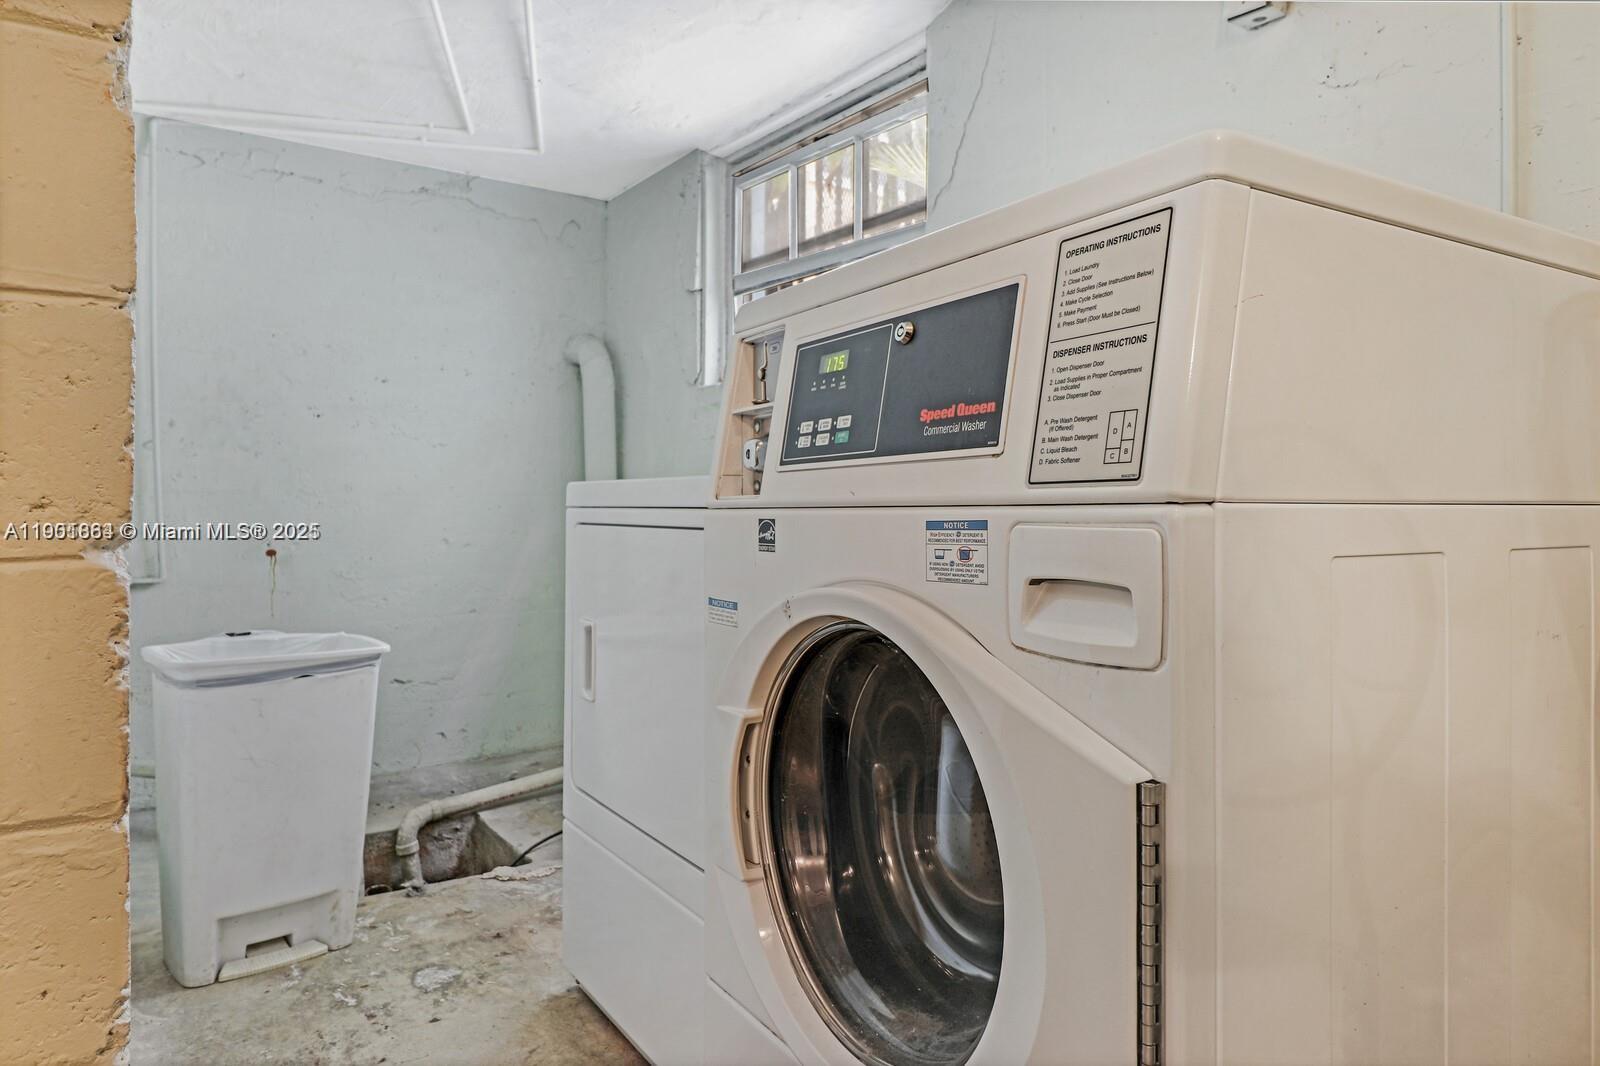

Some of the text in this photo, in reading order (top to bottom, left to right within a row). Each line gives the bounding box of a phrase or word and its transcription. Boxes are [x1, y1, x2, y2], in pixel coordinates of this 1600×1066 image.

[1066, 223, 1161, 259] OPERATING INSTRUCTIONS
[1069, 266, 1080, 275] Load
[1081, 262, 1100, 272] Laundry
[1066, 288, 1075, 296] Add
[1076, 283, 1095, 295] Supplies
[1096, 280, 1107, 290] (See
[1108, 274, 1136, 286] Instructions
[1136, 268, 1154, 279] Below)
[1068, 277, 1081, 286] Close
[1081, 274, 1093, 283] Door
[1065, 298, 1077, 306] Make
[1078, 295, 1091, 305] Cycle
[1092, 290, 1113, 301] Selection
[1062, 319, 1075, 328] Press
[1076, 316, 1087, 325] Start
[1088, 314, 1101, 323] (Door
[1101, 311, 1113, 319] Must
[1121, 305, 1140, 315] Closed)
[1064, 308, 1076, 317] Make
[1077, 304, 1097, 316] Payment
[1052, 334, 1148, 359] DISPENSER INSTRUCTIONS
[825, 354, 846, 372] 175
[1056, 366, 1068, 374] Open
[1069, 362, 1092, 372] Dispenser
[1066, 374, 1086, 384] Supplies
[1092, 371, 1108, 380] Proper
[1109, 366, 1142, 378] Compartment
[1060, 383, 1080, 392] Indicated
[1066, 391, 1089, 401] Dispenser
[919, 400, 996, 423] Speed Queen
[1074, 414, 1098, 424] Detergent
[923, 419, 988, 437] Commercial Washer
[1054, 424, 1074, 432] Offered)
[1074, 433, 1098, 443] Detergent
[712, 600, 734, 608] NOTICE
